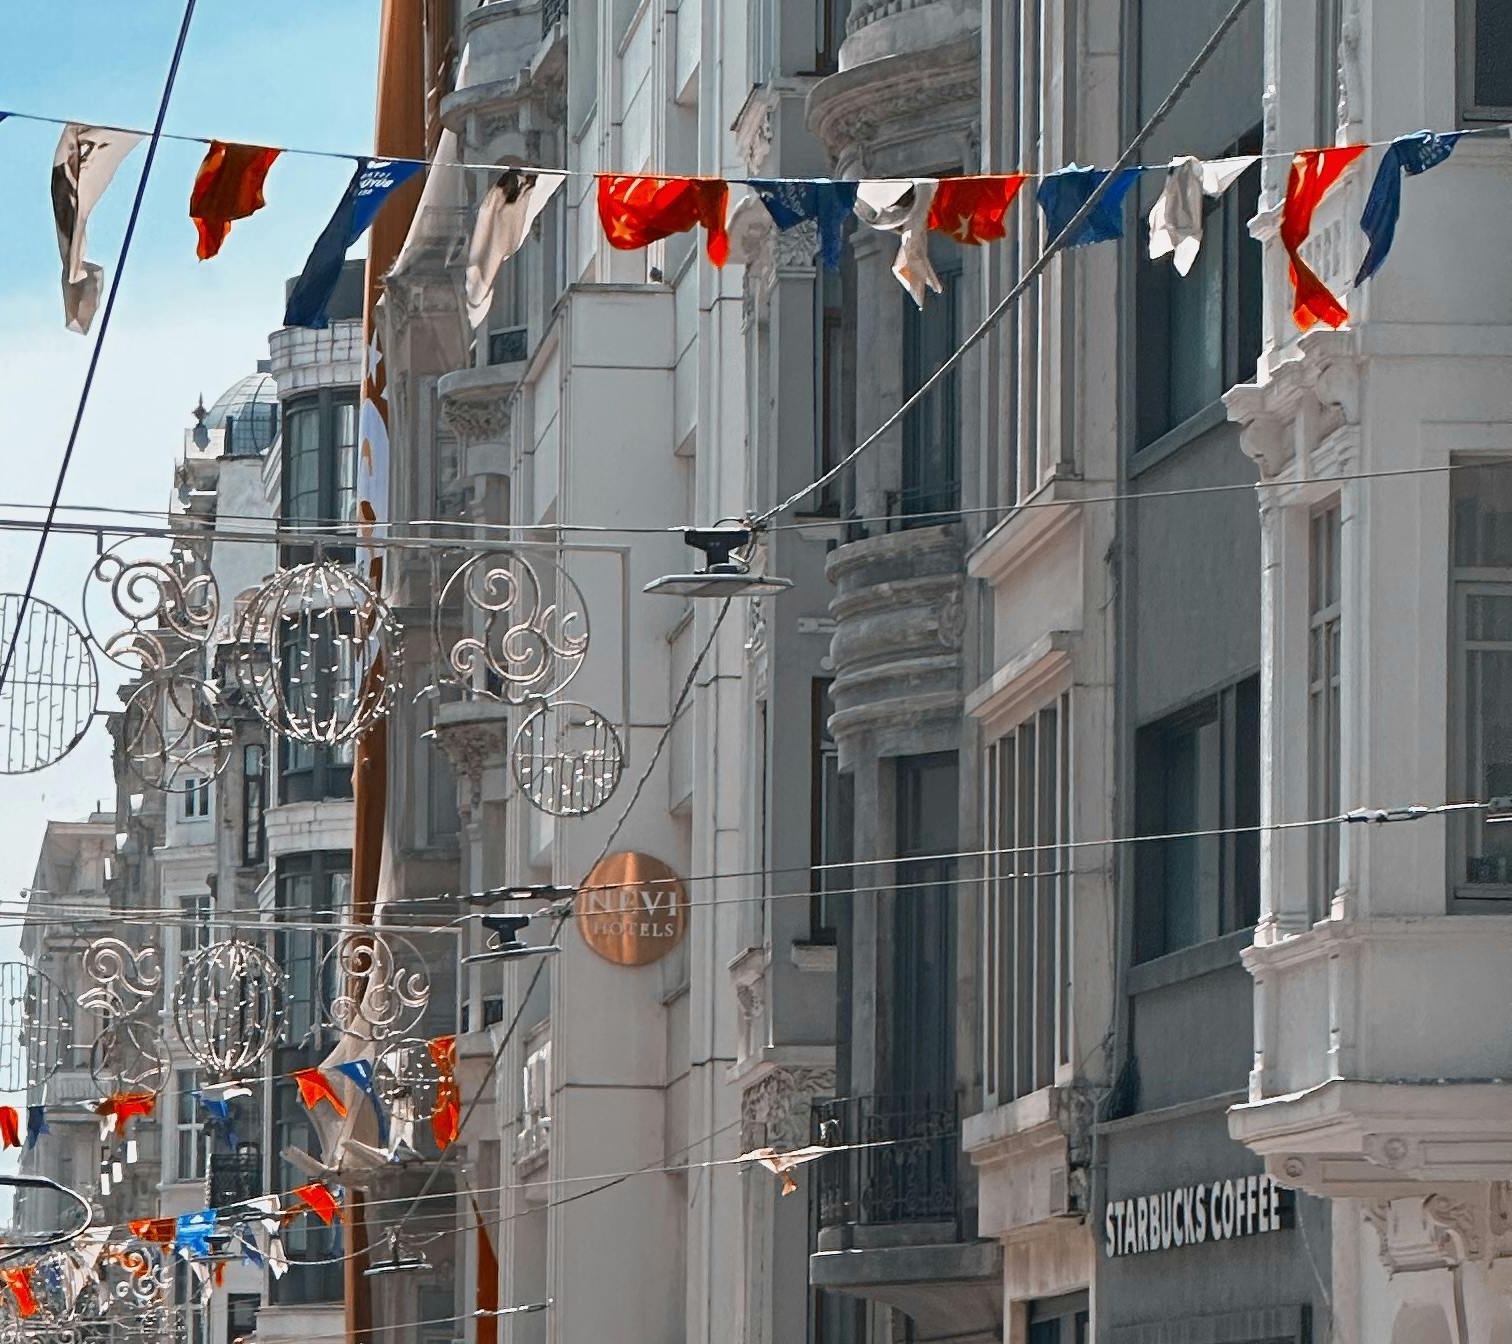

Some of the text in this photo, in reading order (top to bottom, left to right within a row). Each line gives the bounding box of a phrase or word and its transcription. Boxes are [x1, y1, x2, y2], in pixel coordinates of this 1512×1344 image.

[594, 922, 674, 937] HOTELS
[1105, 1174, 1281, 1258] STARBUCKS COFFEE
